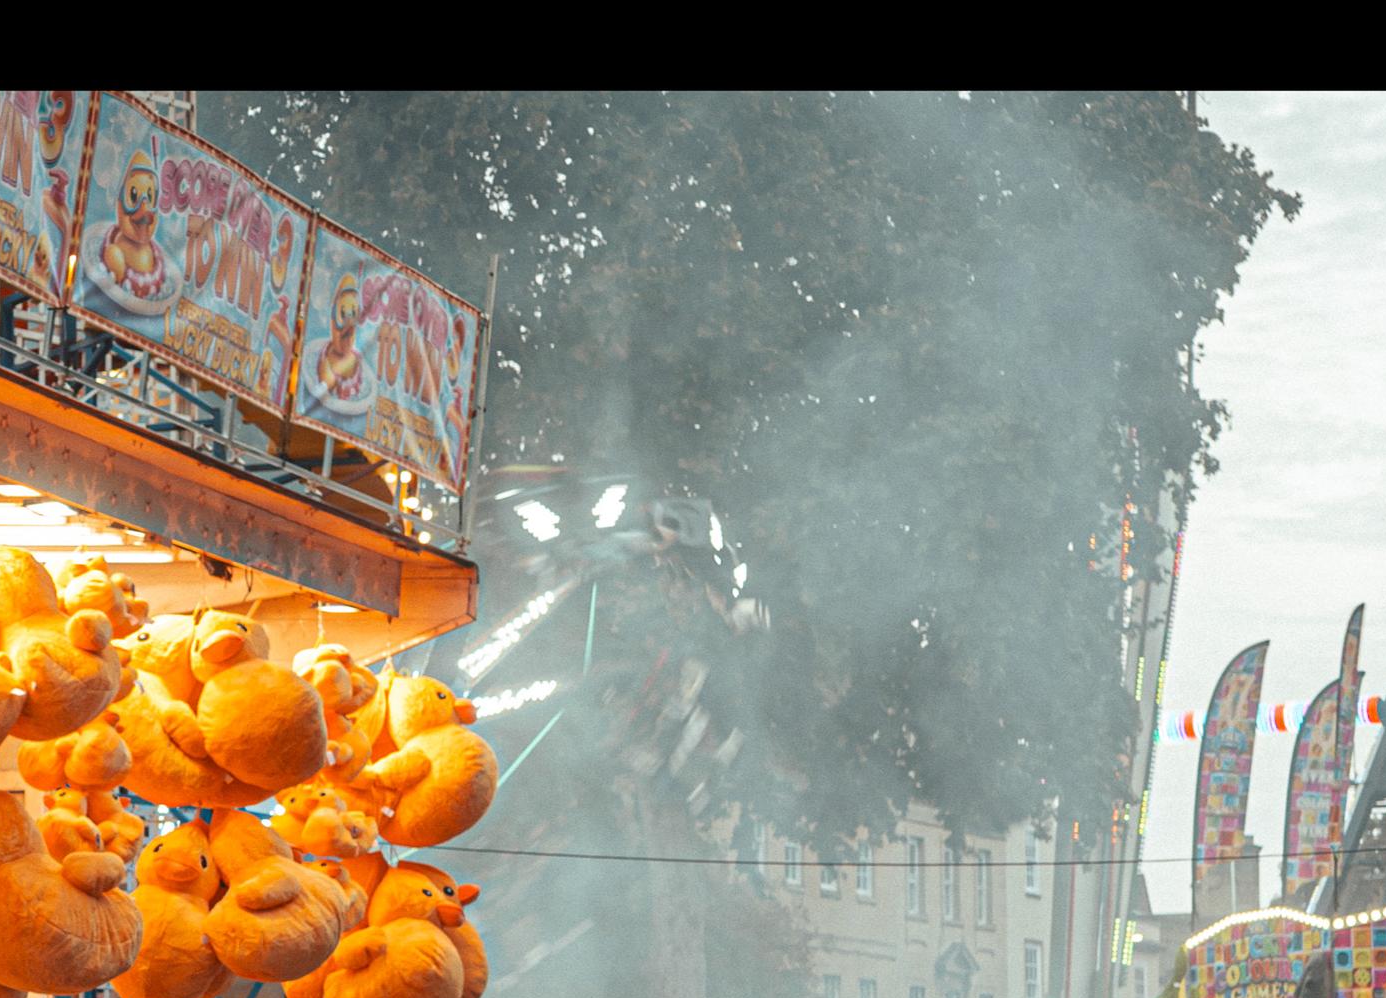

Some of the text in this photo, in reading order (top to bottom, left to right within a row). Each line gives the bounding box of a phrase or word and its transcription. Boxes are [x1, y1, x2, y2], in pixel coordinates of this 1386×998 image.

[159, 160, 232, 221] SCORE
[270, 214, 294, 294] 3
[184, 215, 265, 320] TO WIN
[377, 321, 402, 387] TO
